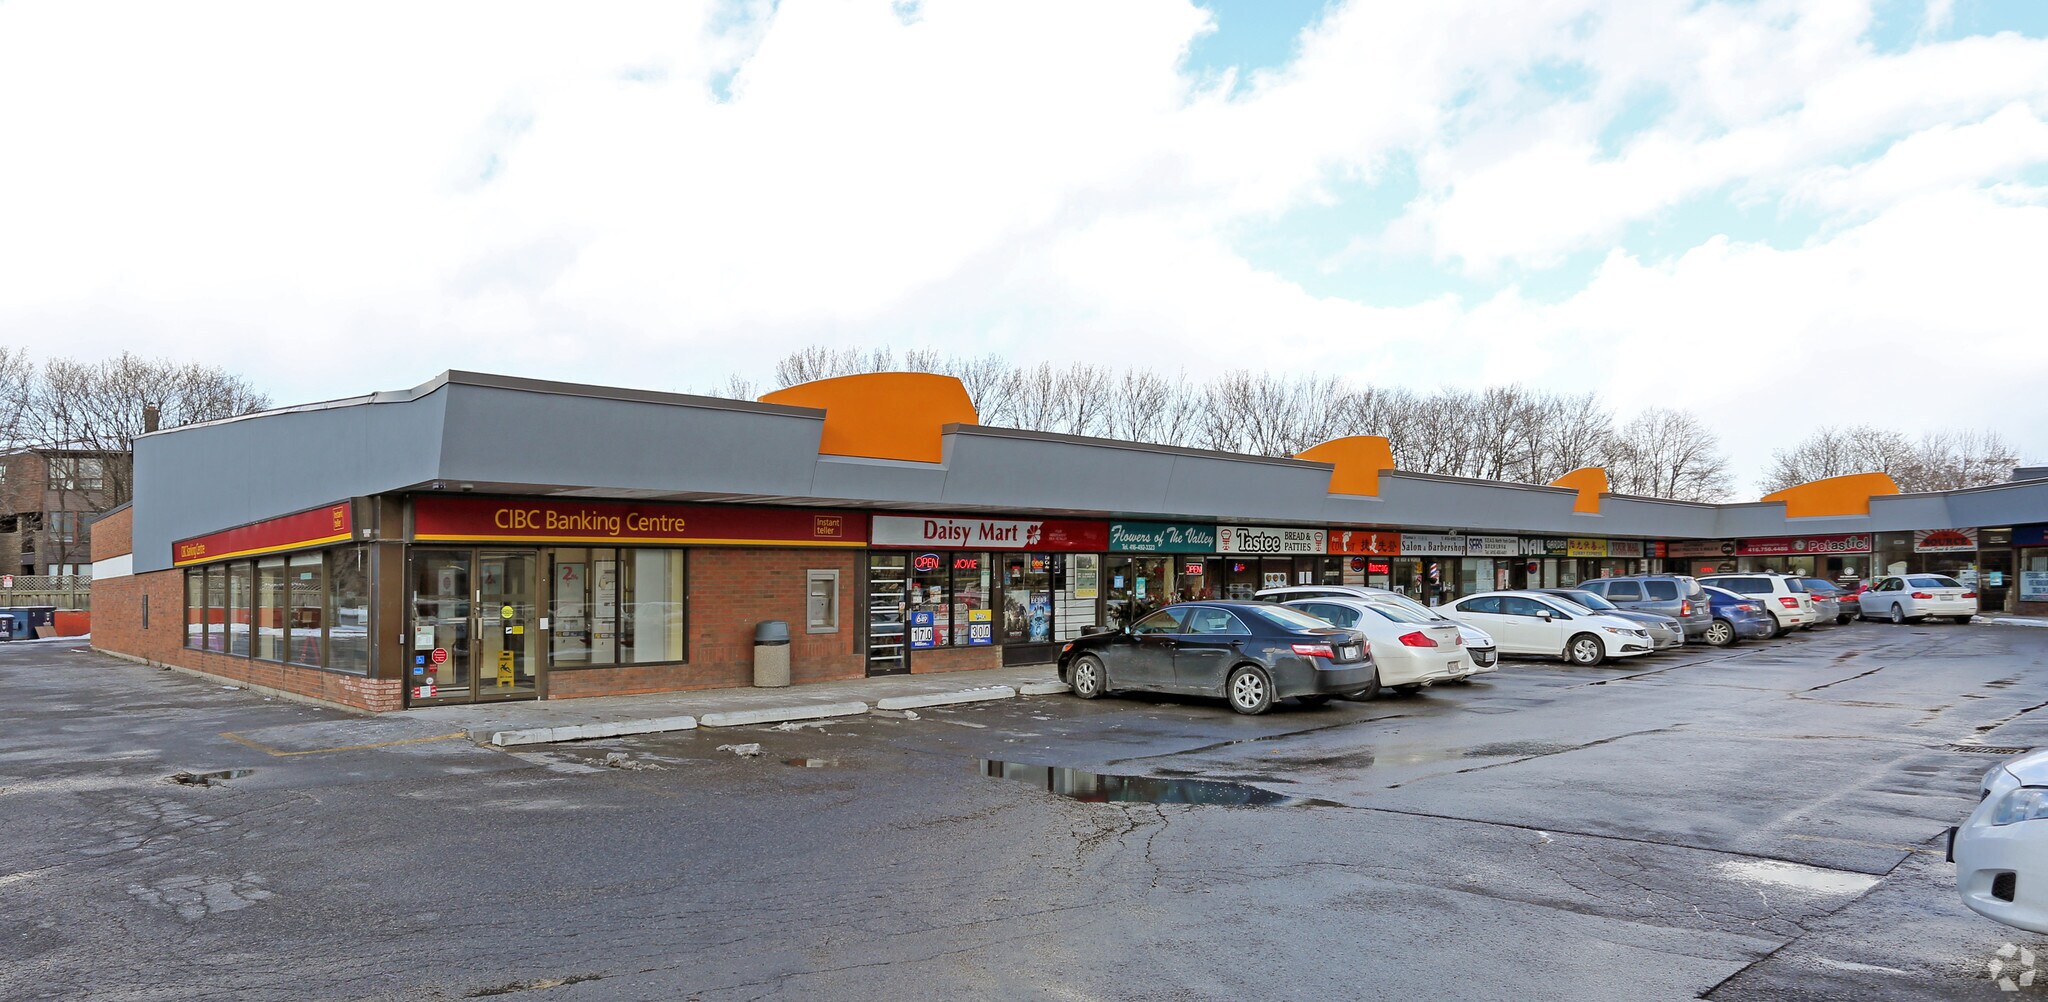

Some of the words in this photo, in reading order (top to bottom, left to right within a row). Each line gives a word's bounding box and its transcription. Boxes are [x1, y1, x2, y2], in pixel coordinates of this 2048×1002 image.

[495, 509, 541, 530] CIBC
[546, 510, 620, 536] Banking
[626, 513, 685, 532] Centre
[816, 518, 840, 527] Instant
[816, 526, 834, 535] teller
[923, 520, 972, 547] Daisy
[979, 522, 1018, 541] Mart
[1111, 525, 1151, 544] Flowers
[1154, 530, 1165, 547] of
[1166, 527, 1183, 544] The
[1185, 527, 1214, 547] Valley
[1236, 528, 1281, 553] Tastee
[1284, 531, 1304, 541] BREAD
[1306, 532, 1311, 541] &
[1284, 542, 1311, 552] PATTIES
[1401, 541, 1422, 552] Salon
[1428, 541, 1466, 555] Barbershop
[1519, 539, 1547, 556] NAIL
[1808, 536, 1869, 552] Petastic!
[914, 556, 939, 569] OPEN
